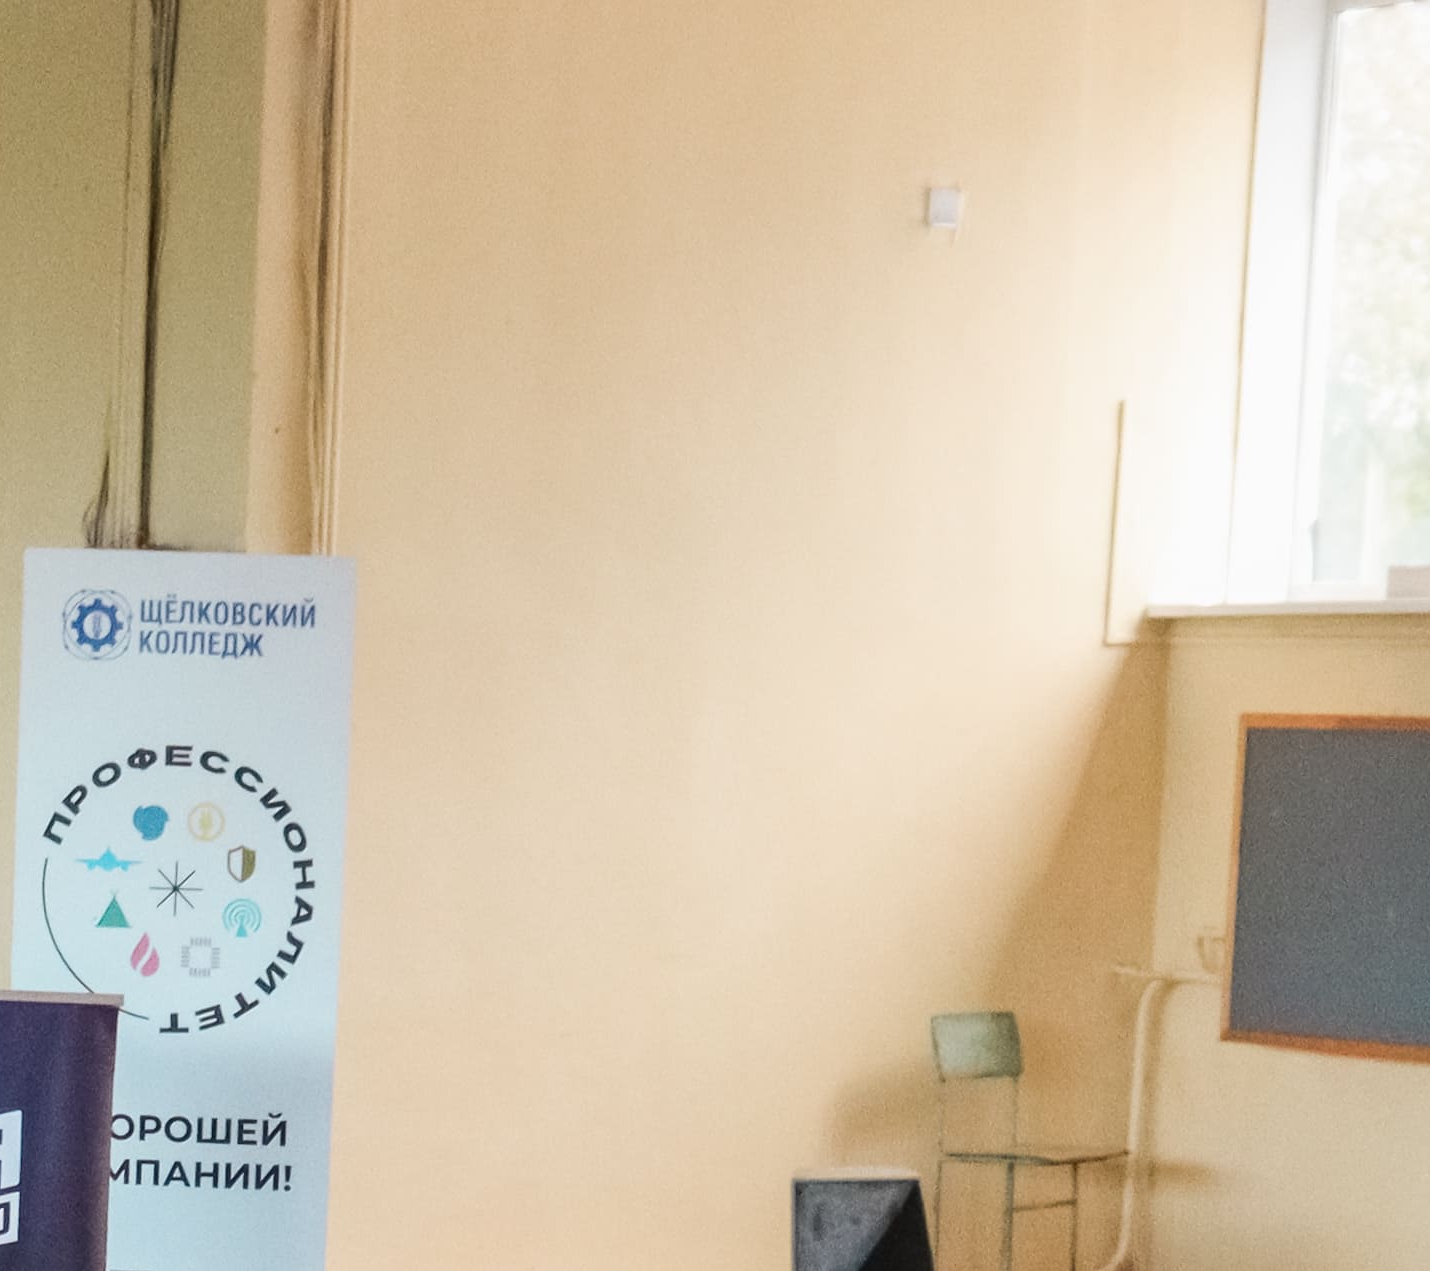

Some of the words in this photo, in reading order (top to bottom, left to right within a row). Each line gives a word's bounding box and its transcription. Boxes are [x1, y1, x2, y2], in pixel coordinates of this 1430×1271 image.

[139, 593, 317, 629] ЩЁЛКОВСКИЙ
[139, 630, 265, 659] КОЛЛЕДЖ
[42, 744, 316, 1034] ПРОФЕССИОНАЛИТЕТ
[110, 1112, 288, 1148] ОРОШЕЙ
[109, 1158, 294, 1192] МПАНИИ!
